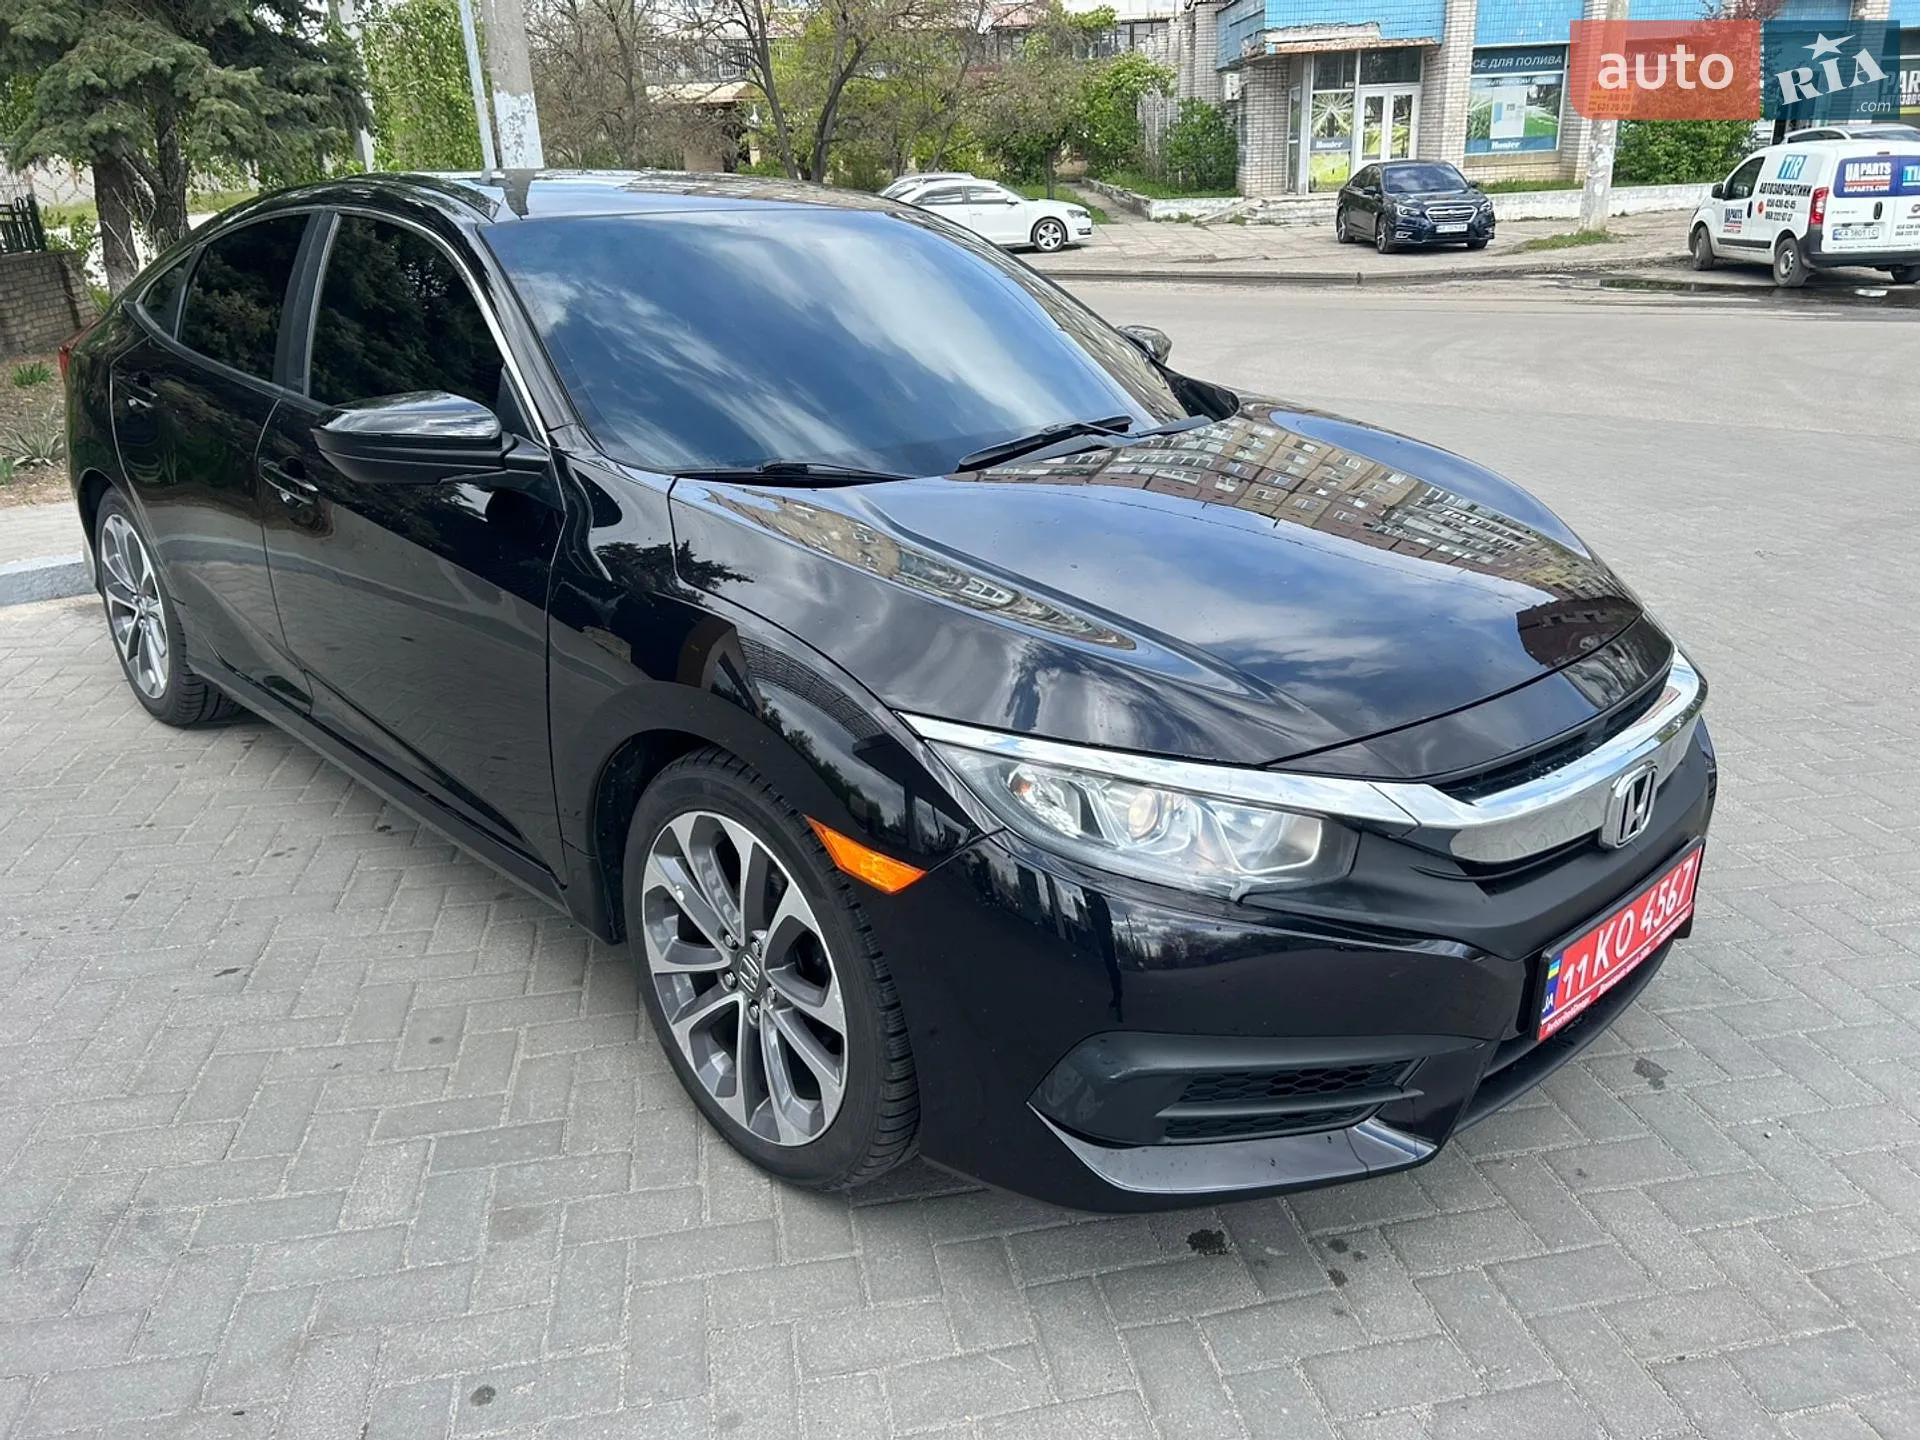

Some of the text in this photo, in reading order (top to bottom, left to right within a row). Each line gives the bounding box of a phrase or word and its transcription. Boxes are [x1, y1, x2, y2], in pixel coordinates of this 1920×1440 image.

[1488, 58, 1514, 69] ДЛЯ
[1516, 55, 1562, 66] ПОЛИВА
[1779, 155, 1806, 179] TIR
[1563, 954, 1588, 1000] 11
[1592, 909, 1635, 978] KO
[1640, 857, 1694, 935] 4567
